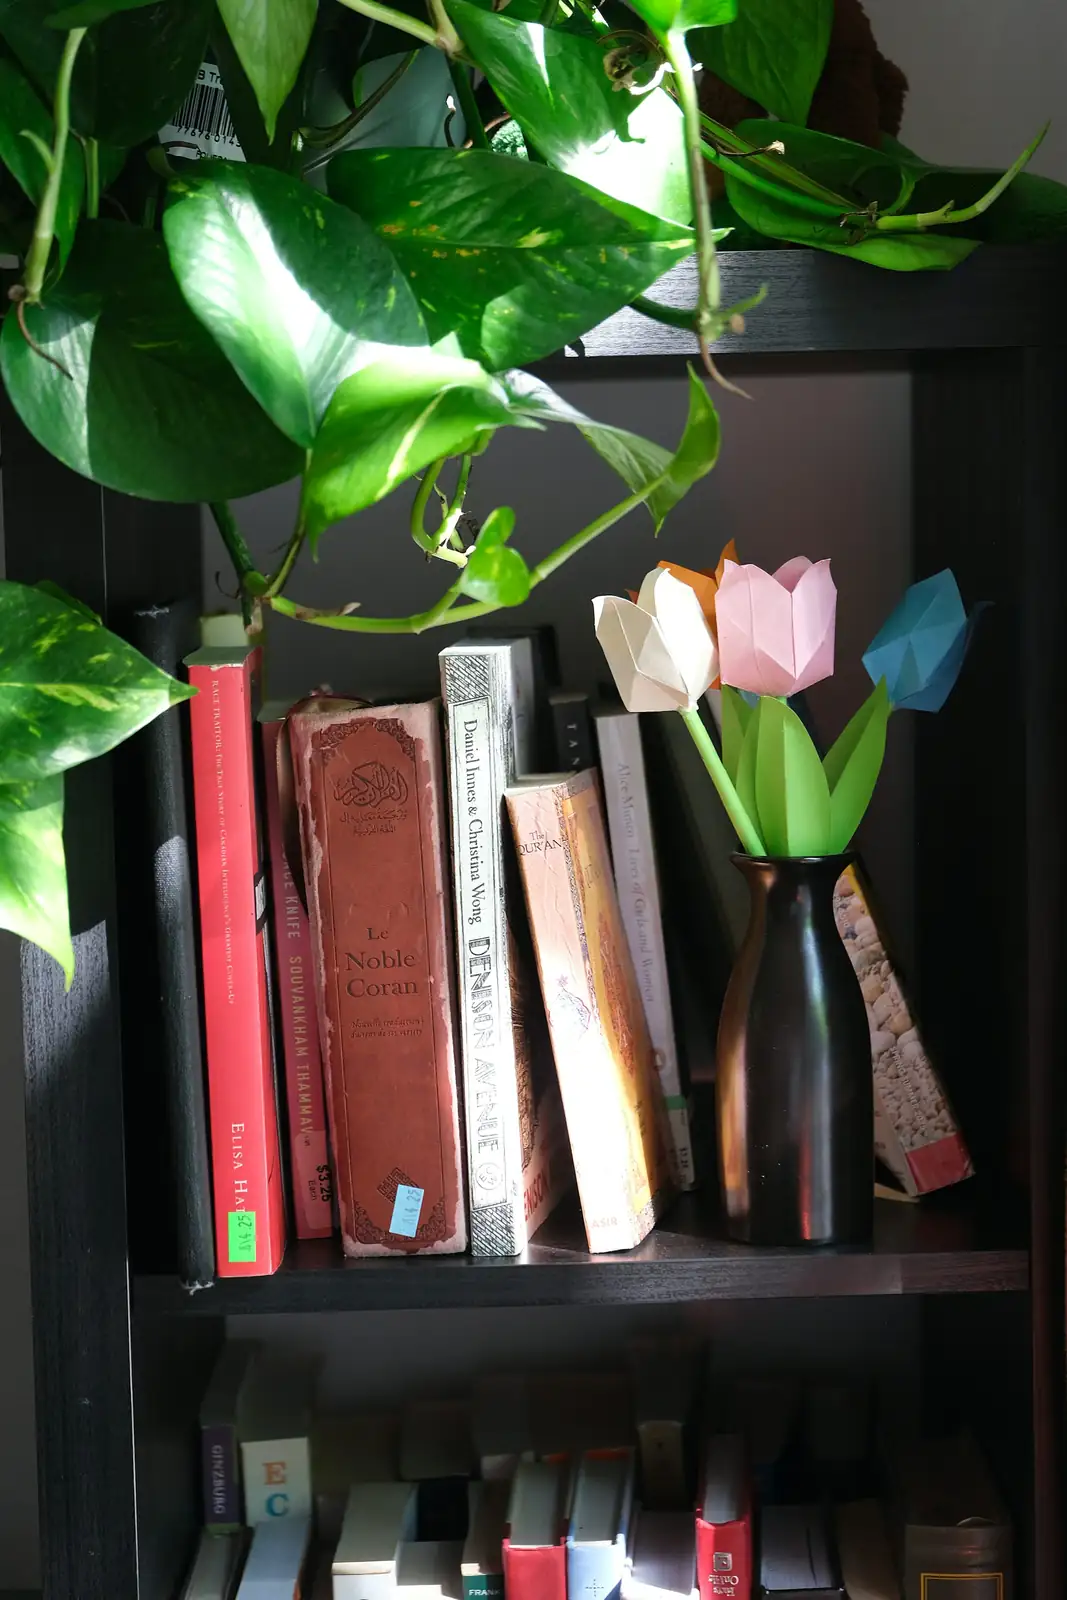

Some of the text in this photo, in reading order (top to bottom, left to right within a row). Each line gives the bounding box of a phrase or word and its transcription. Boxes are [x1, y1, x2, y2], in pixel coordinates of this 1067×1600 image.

[617, 763, 631, 792] Alice
[463, 719, 487, 925] Daniel Innes & Christina Wong
[529, 830, 544, 841] The
[286, 895, 301, 939] KNIFE
[367, 927, 389, 940] Le
[344, 949, 417, 971] Noble
[639, 931, 653, 953] and
[346, 978, 419, 998] Coran
[641, 958, 657, 1002] Women
[288, 955, 310, 1057] SOUVANKHAM
[468, 937, 499, 1154] DENISON AVENUE
[296, 1064, 313, 1135] THAMMAV
